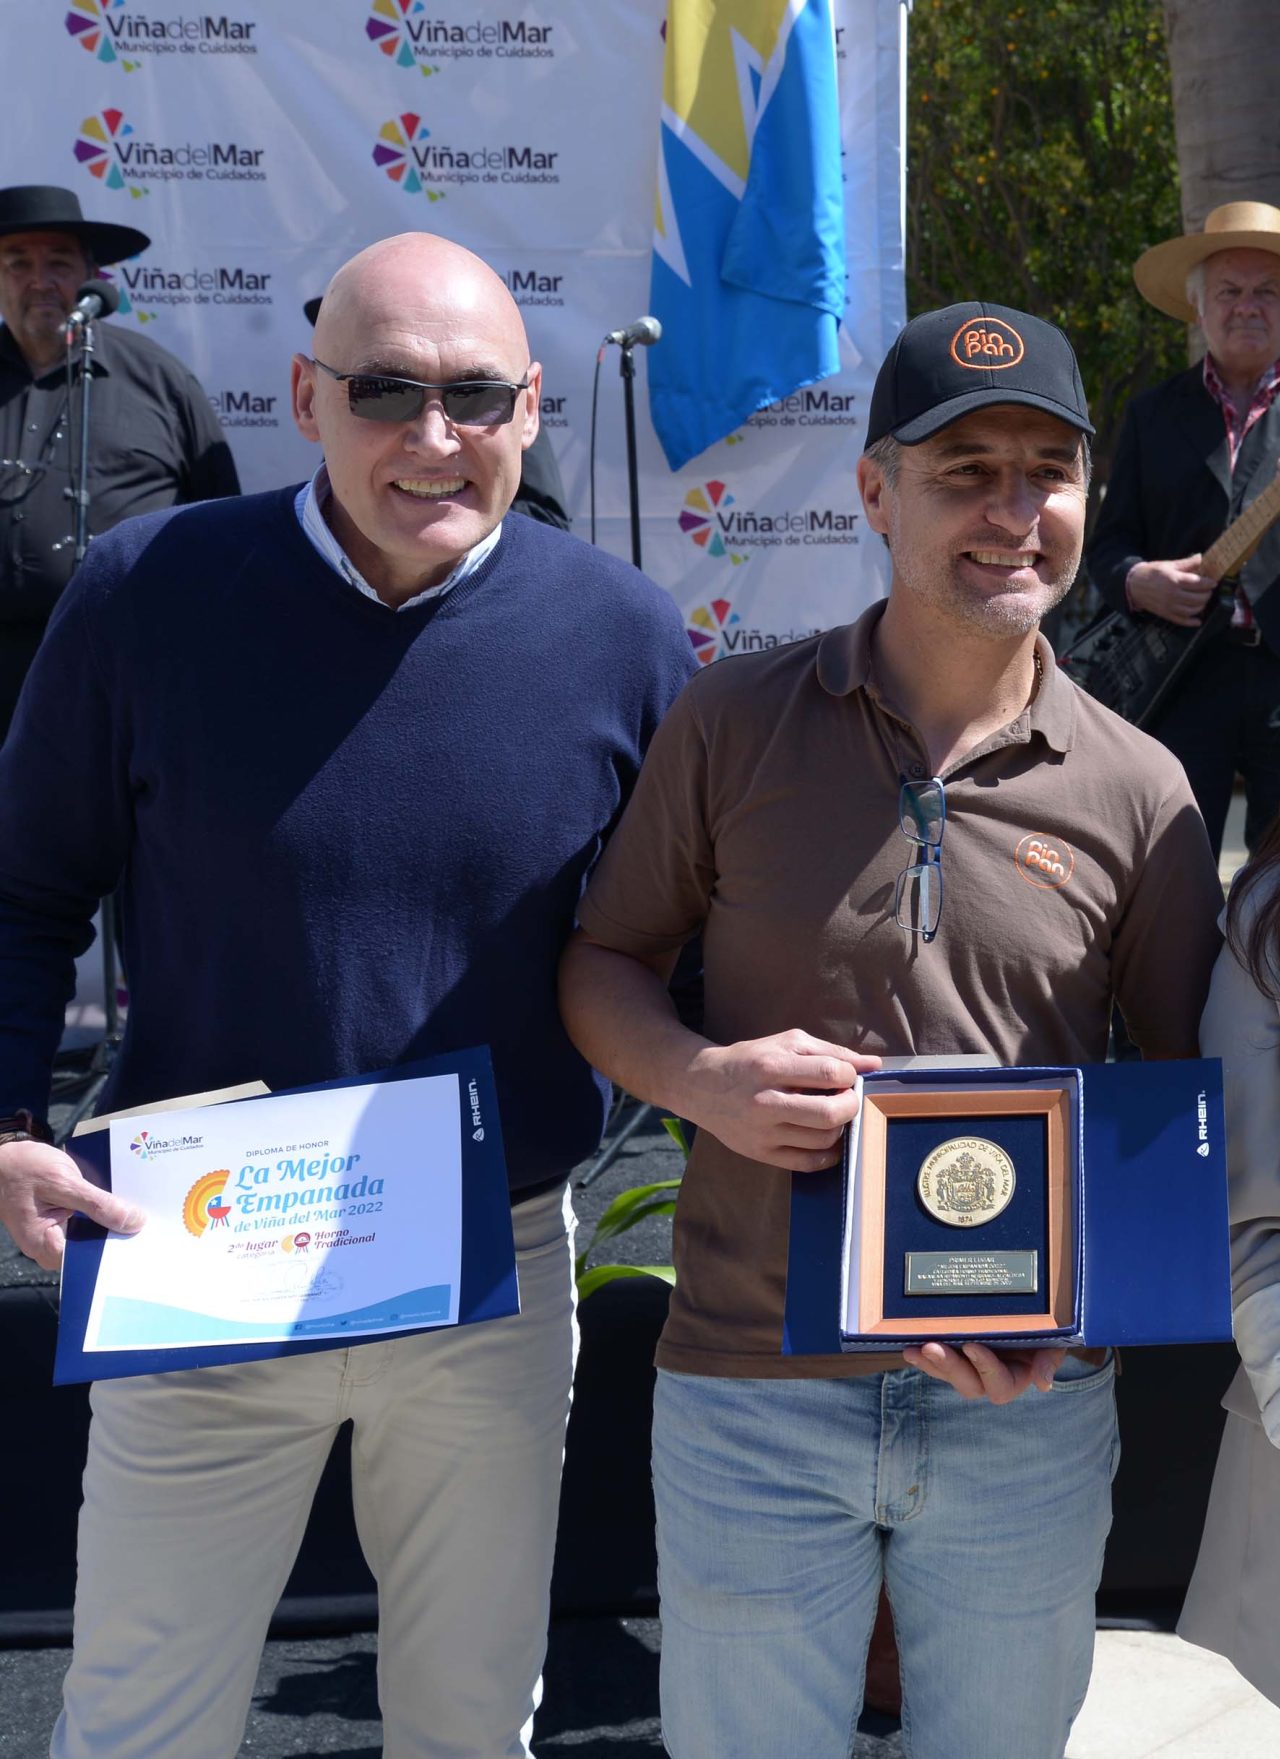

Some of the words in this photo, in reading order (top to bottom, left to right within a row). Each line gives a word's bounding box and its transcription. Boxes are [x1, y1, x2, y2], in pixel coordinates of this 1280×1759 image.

[106, 15, 256, 39] ViñadelMar
[405, 19, 553, 43] ViñadelMar
[114, 41, 177, 54] Municipio
[179, 42, 196, 53] de
[199, 43, 258, 54] Cuidados
[414, 46, 475, 59] Municipio
[477, 46, 493, 57] de
[495, 46, 554, 58] Cuidados
[114, 142, 264, 166] ViñadelMar
[411, 146, 558, 169] ViñadelMar
[123, 168, 184, 182] Municipio
[187, 169, 203, 180] de
[206, 169, 266, 181] Cuidados
[421, 171, 479, 185] Municipio
[482, 172, 498, 183] de
[501, 172, 560, 183] Cuidados
[122, 267, 271, 290] ViñadelMar
[130, 292, 191, 306] Municipio
[194, 293, 209, 304] de
[213, 293, 273, 304] Cuidados
[516, 295, 564, 306] uidados
[780, 415, 796, 426] de
[798, 415, 856, 426] Cuidados
[717, 510, 858, 532] ViñadelMar
[725, 536, 782, 547] Municipio
[785, 535, 800, 545] de
[803, 534, 858, 545] Cuidados
[246, 1147, 284, 1158] DIPLOMA
[299, 1140, 329, 1151] HONOR
[235, 1165, 270, 1190] La
[276, 1153, 360, 1181] Mejor
[236, 1175, 384, 1214] Empanada
[234, 1220, 251, 1233] de
[254, 1216, 285, 1230] Viña
[288, 1211, 310, 1225] del
[313, 1207, 346, 1222] Mar
[348, 1201, 384, 1216] 2022
[314, 1228, 350, 1241] Horno
[314, 1233, 376, 1249] Tradicional
[246, 1239, 279, 1252] lugar
